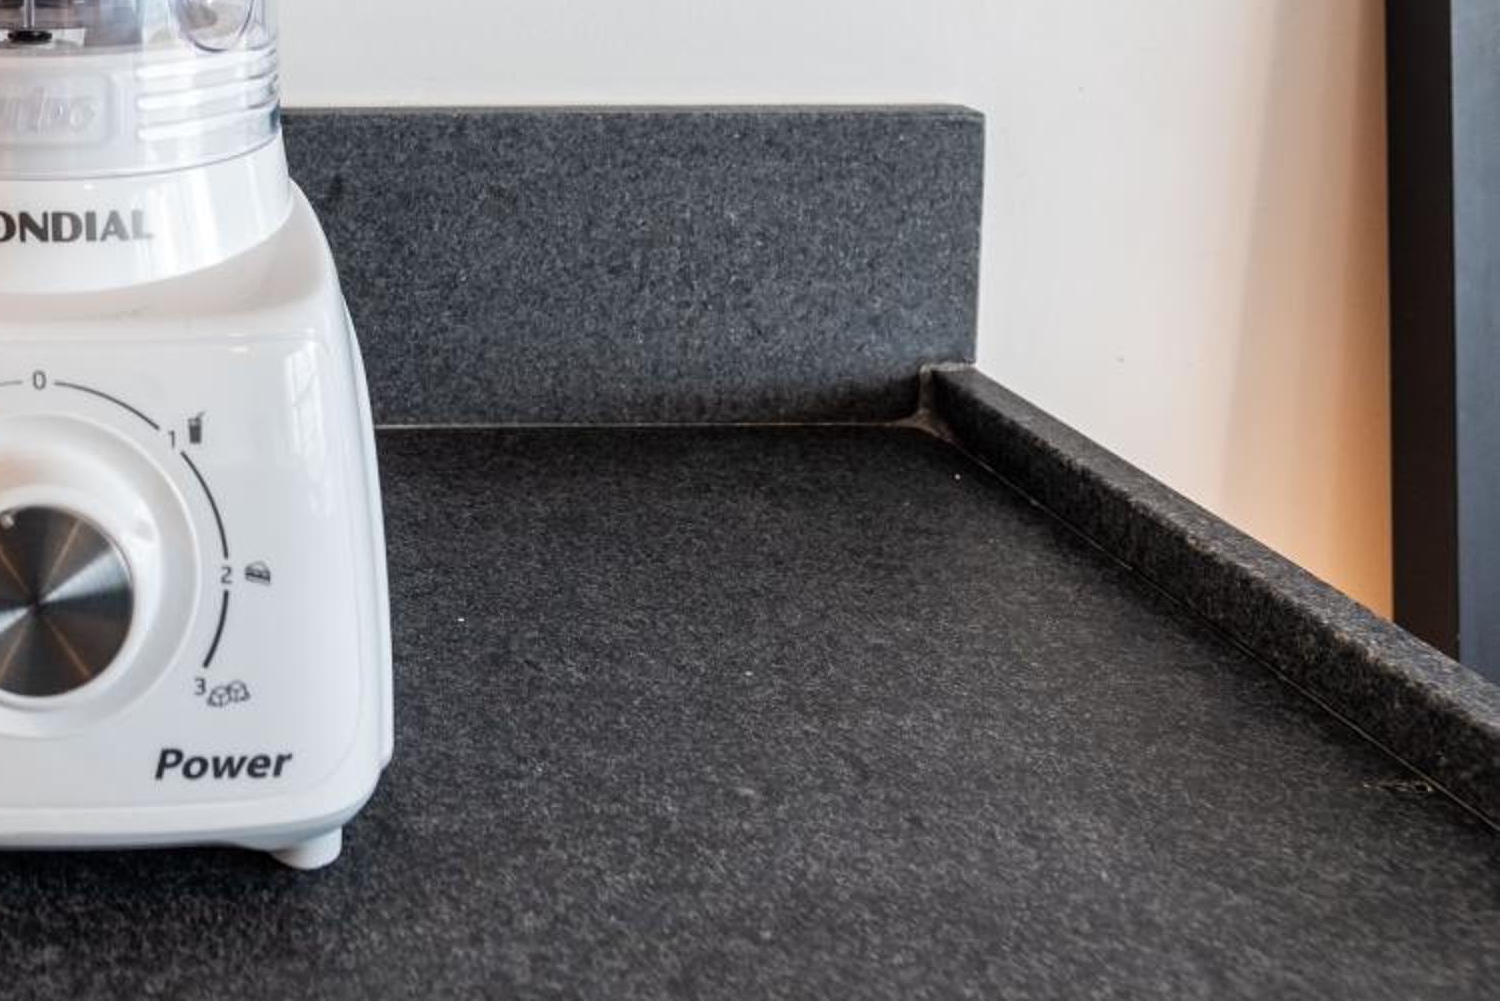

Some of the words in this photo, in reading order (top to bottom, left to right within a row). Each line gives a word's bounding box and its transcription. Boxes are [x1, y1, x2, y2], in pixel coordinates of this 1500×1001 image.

[32, 370, 47, 391] 0
[167, 430, 177, 449] 1
[221, 566, 233, 584] 2
[194, 677, 207, 697] 3
[155, 747, 294, 781] Power
